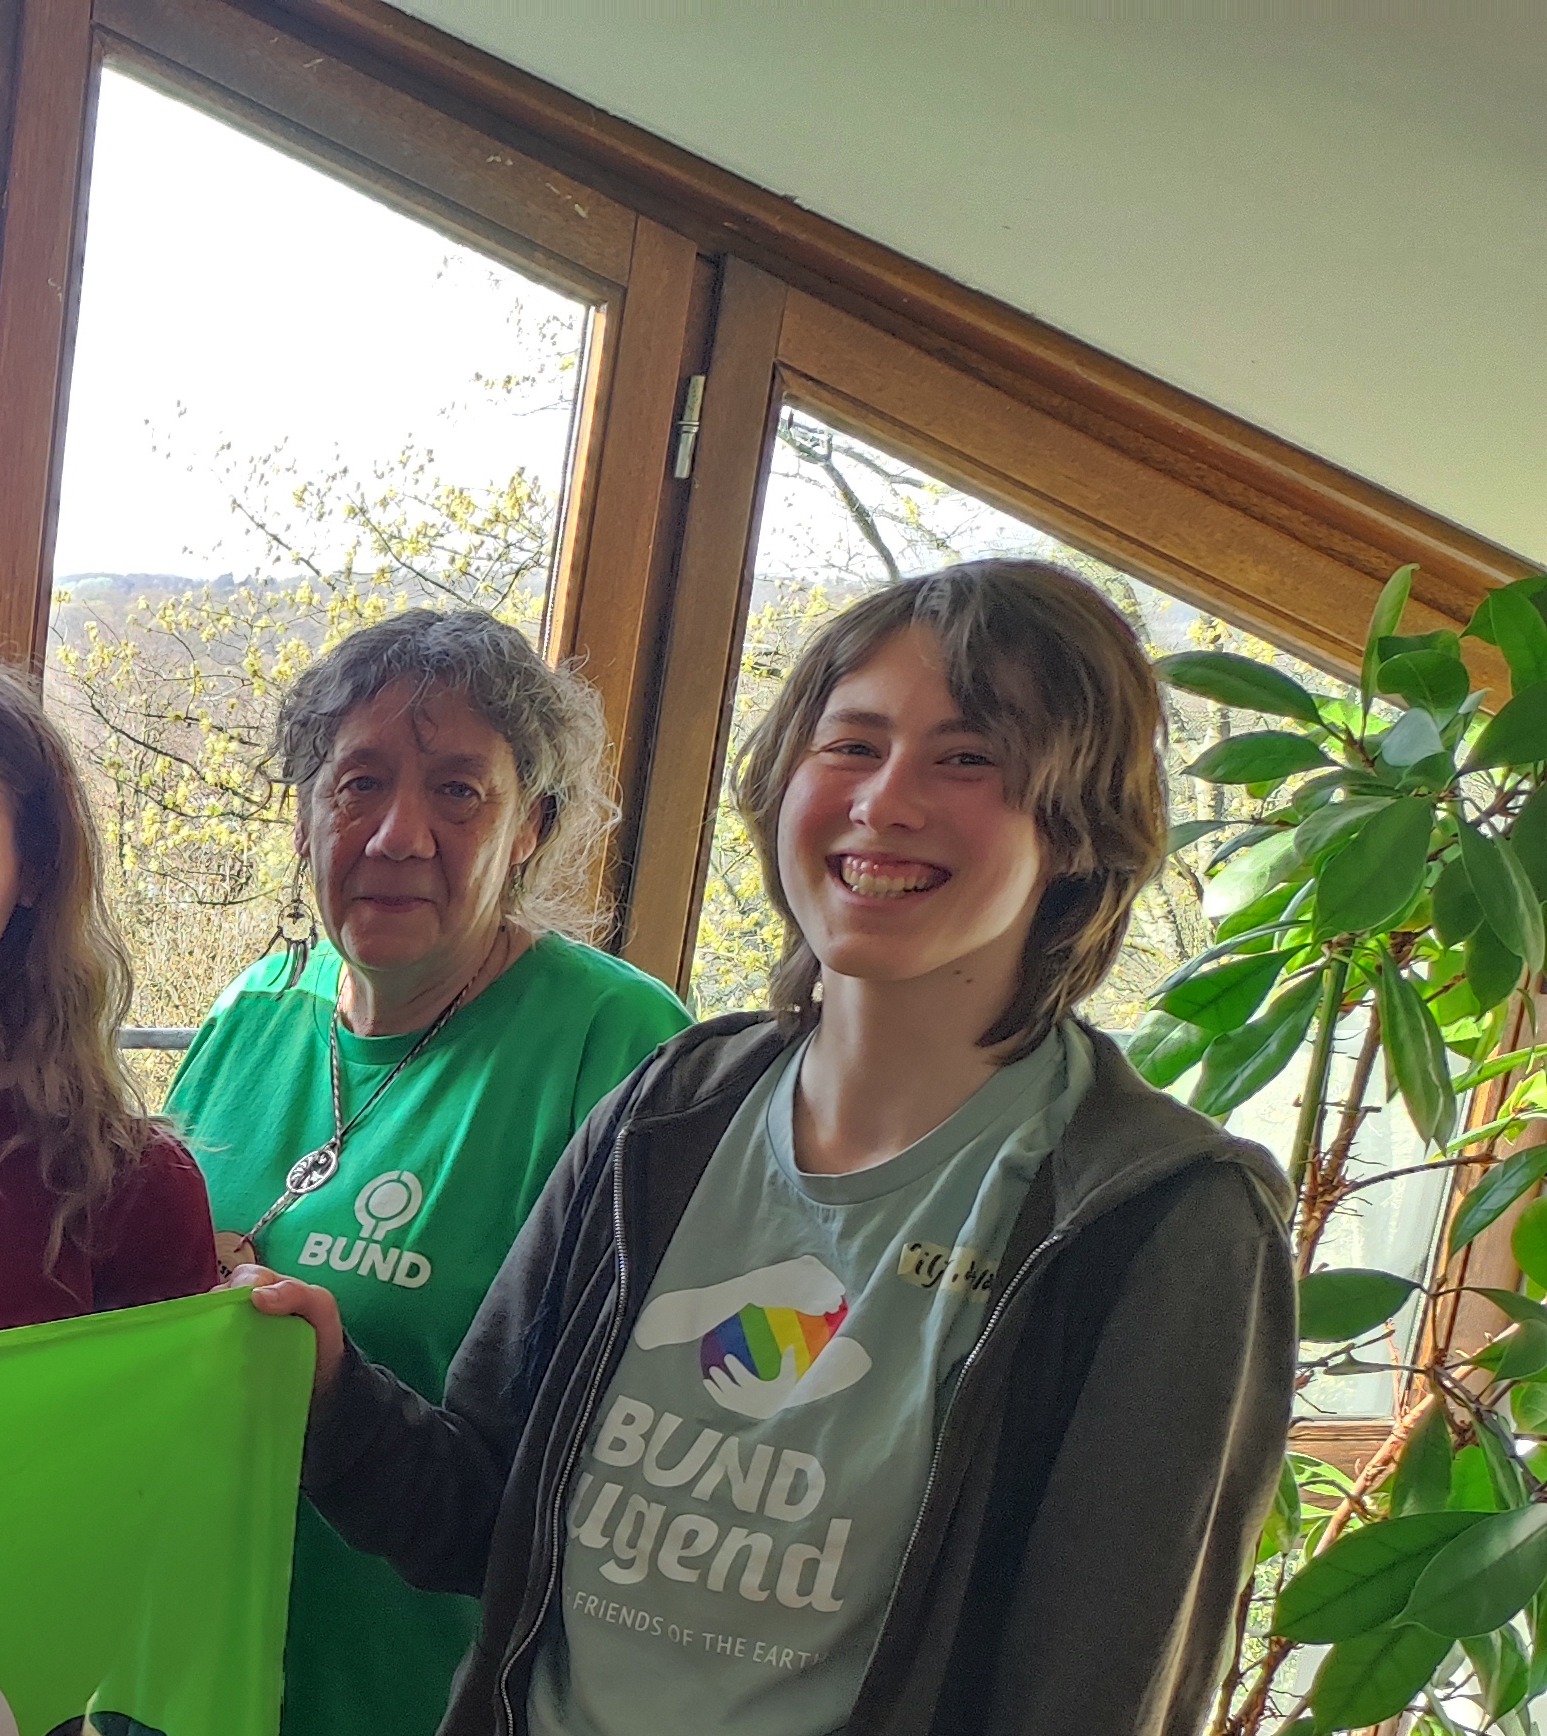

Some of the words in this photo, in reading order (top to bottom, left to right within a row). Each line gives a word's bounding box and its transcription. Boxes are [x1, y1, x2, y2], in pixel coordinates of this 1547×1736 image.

[298, 1231, 432, 1289] BUND
[593, 1394, 826, 1522] BUND
[567, 1472, 853, 1613] ugend
[572, 1590, 664, 1636] FRIENDS
[668, 1624, 694, 1647] OF
[702, 1632, 748, 1657] THE
